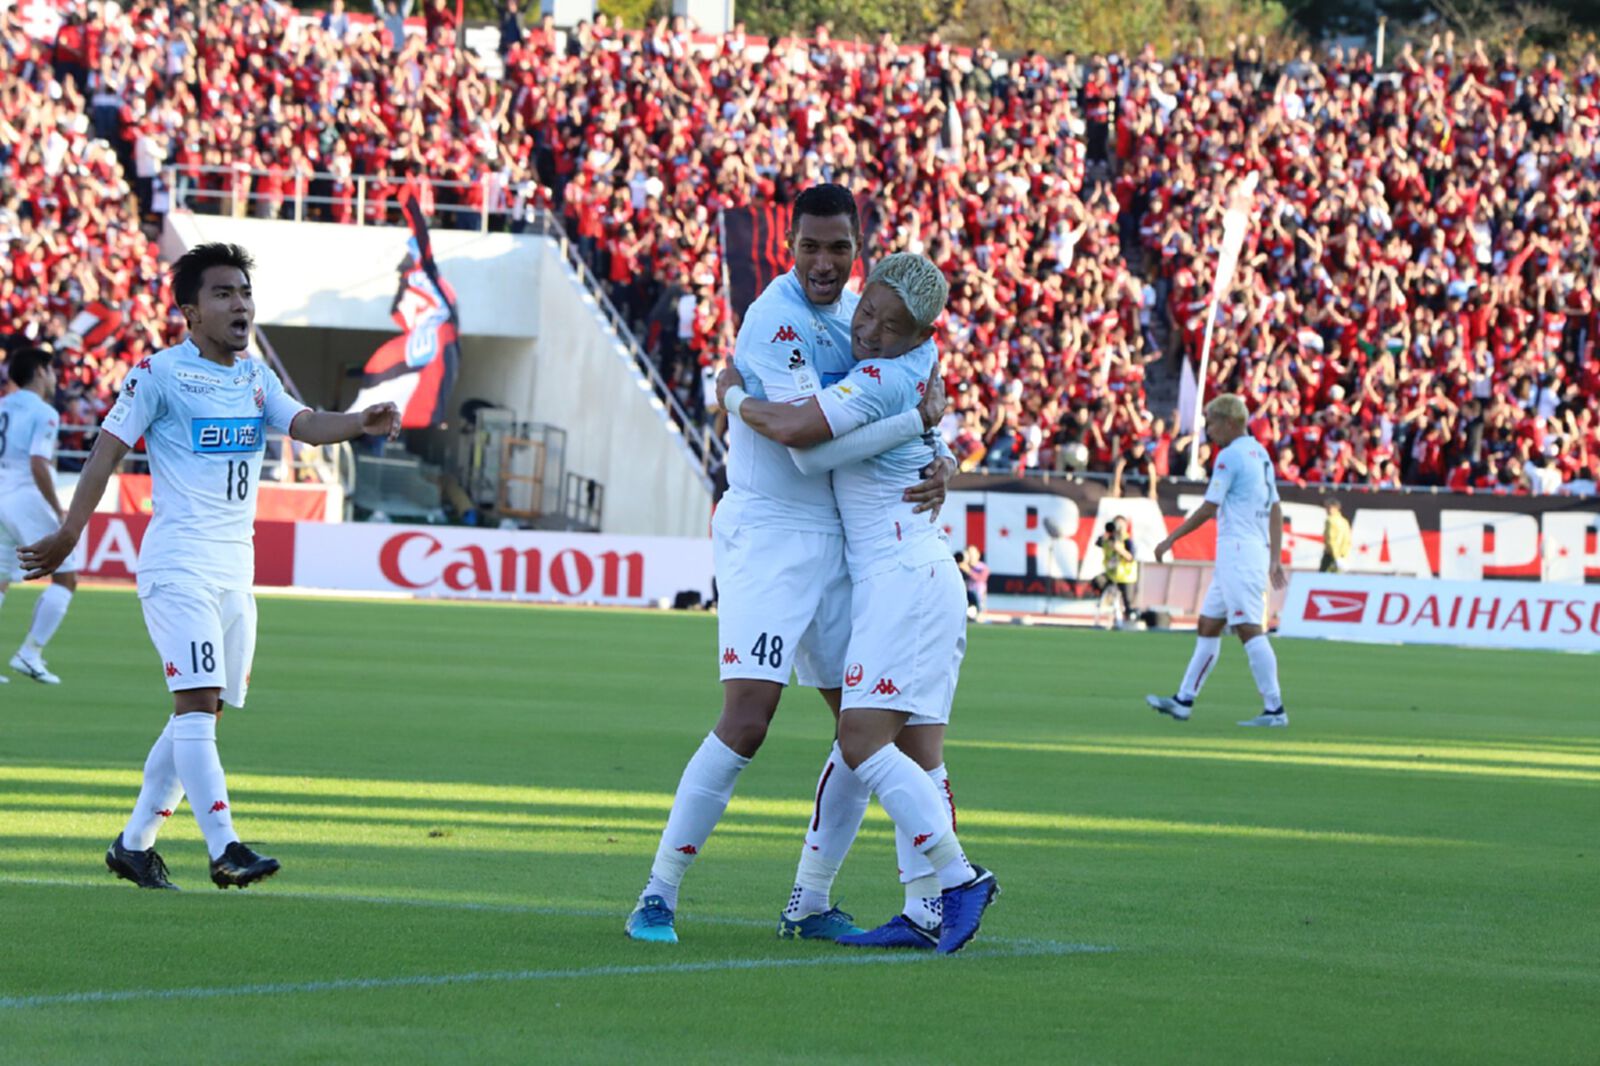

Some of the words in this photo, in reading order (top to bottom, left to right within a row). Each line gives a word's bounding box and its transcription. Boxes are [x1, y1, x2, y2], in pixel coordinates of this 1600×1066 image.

[199, 424, 262, 447] 白い恋
[226, 460, 249, 501] 18
[378, 530, 645, 599] Canon
[190, 640, 216, 674] 18
[750, 632, 784, 669] 48
